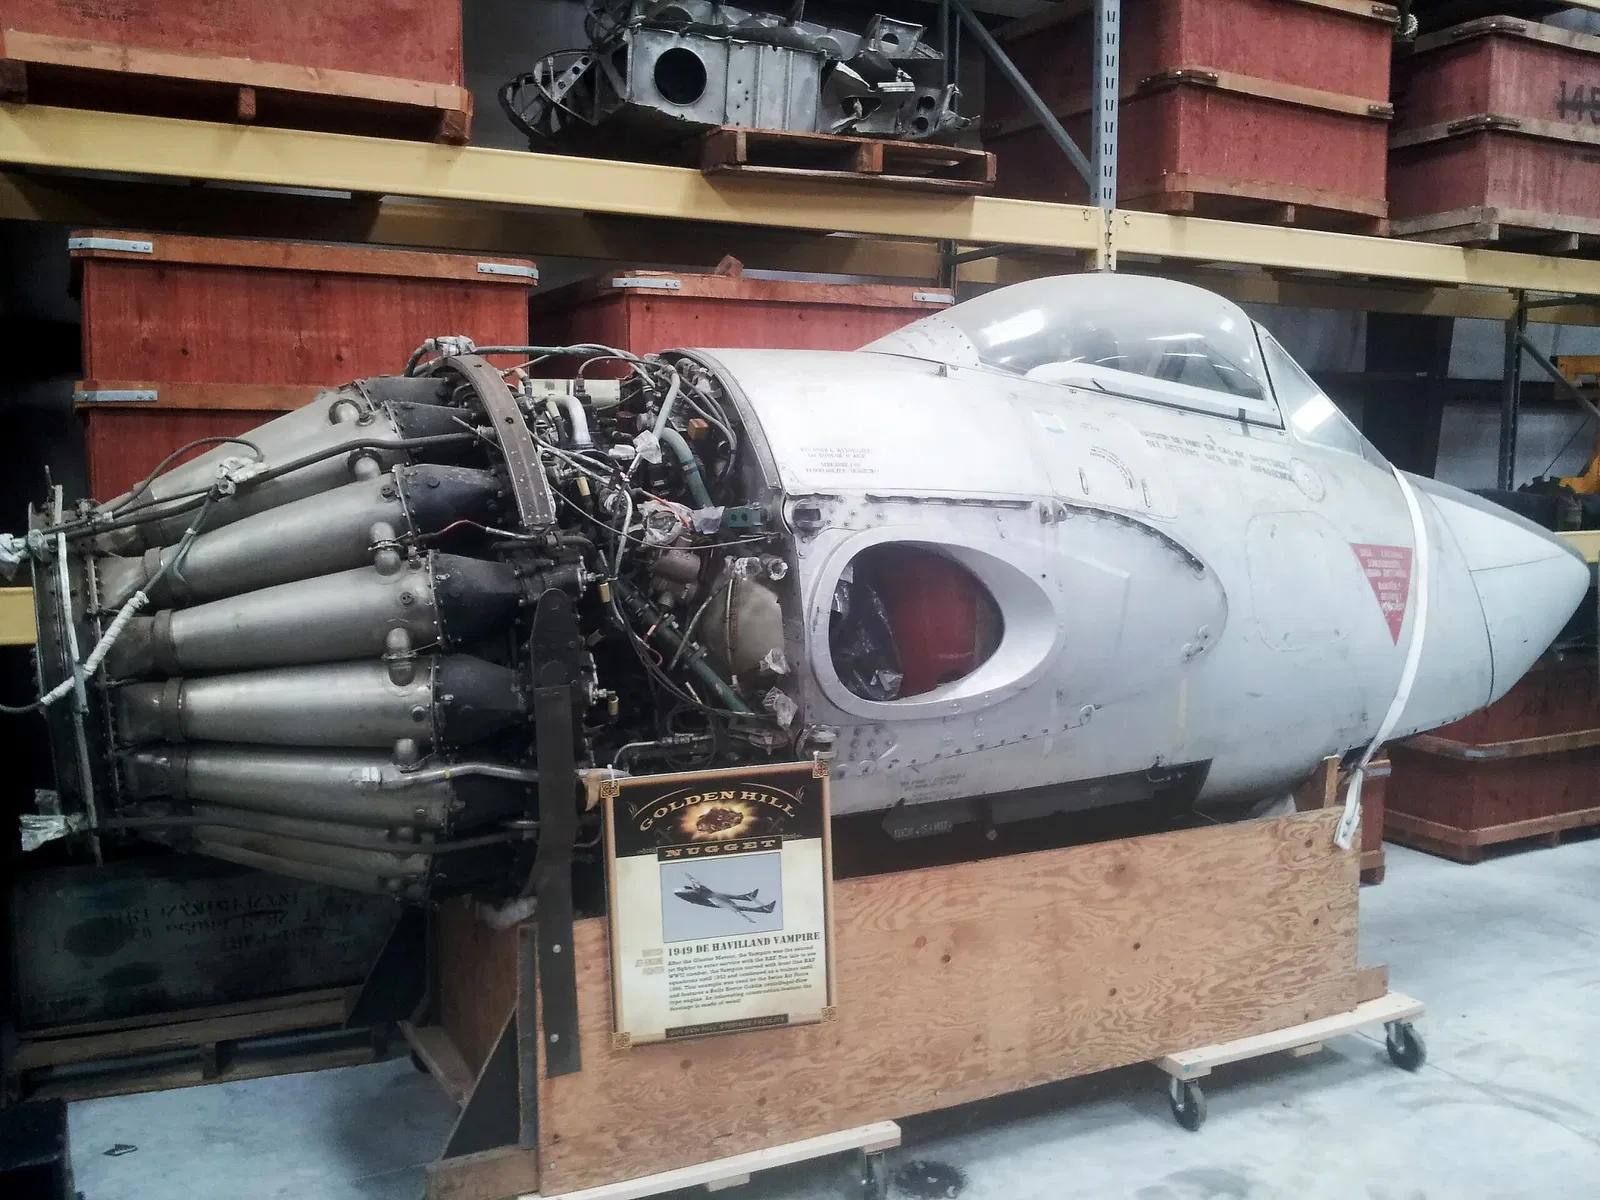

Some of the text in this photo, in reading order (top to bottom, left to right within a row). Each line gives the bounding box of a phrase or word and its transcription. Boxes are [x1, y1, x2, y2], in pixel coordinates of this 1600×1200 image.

[639, 791, 796, 831] GOLDEN HILL
[665, 839, 776, 857] NUGGET
[668, 932, 820, 957] 1949 DE HAVILLAND VAMPIRE
